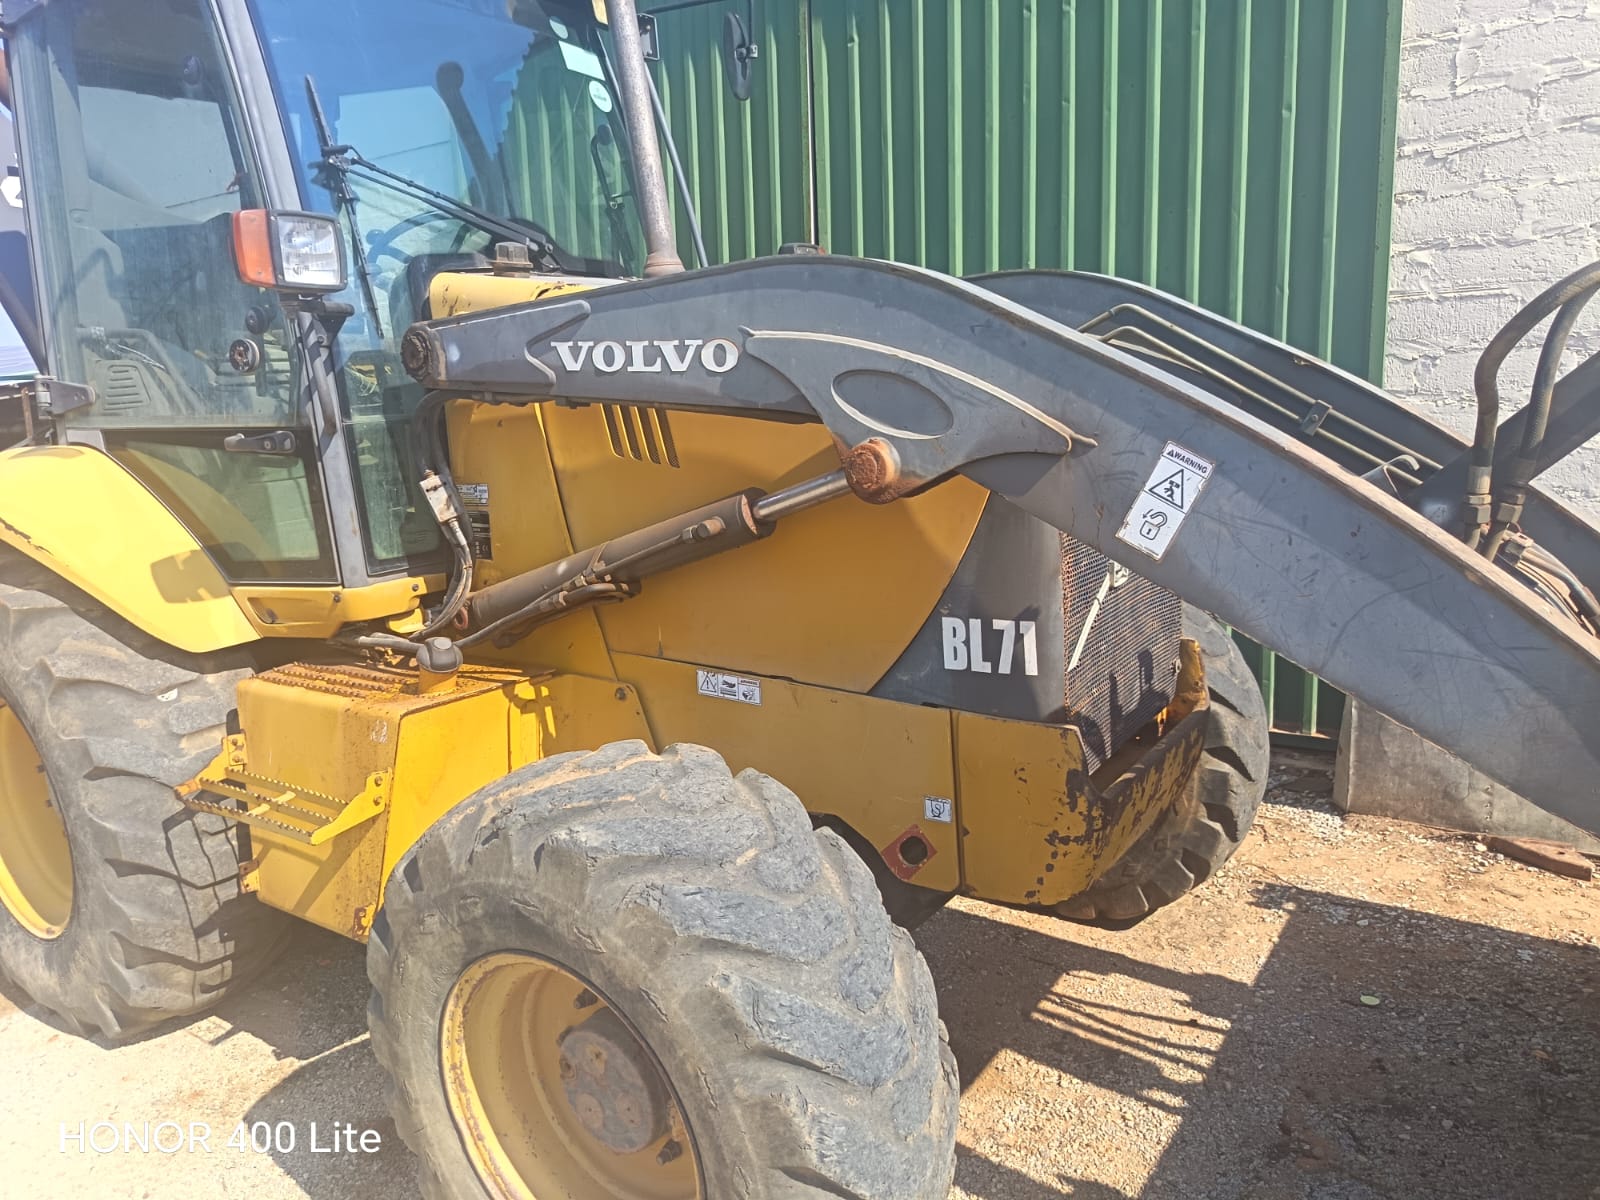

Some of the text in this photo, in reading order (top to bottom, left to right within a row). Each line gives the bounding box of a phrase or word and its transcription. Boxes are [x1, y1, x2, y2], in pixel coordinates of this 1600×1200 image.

[551, 339, 739, 373] VOLVO
[1174, 451, 1208, 474] WARNING
[941, 617, 1038, 676] BL71
